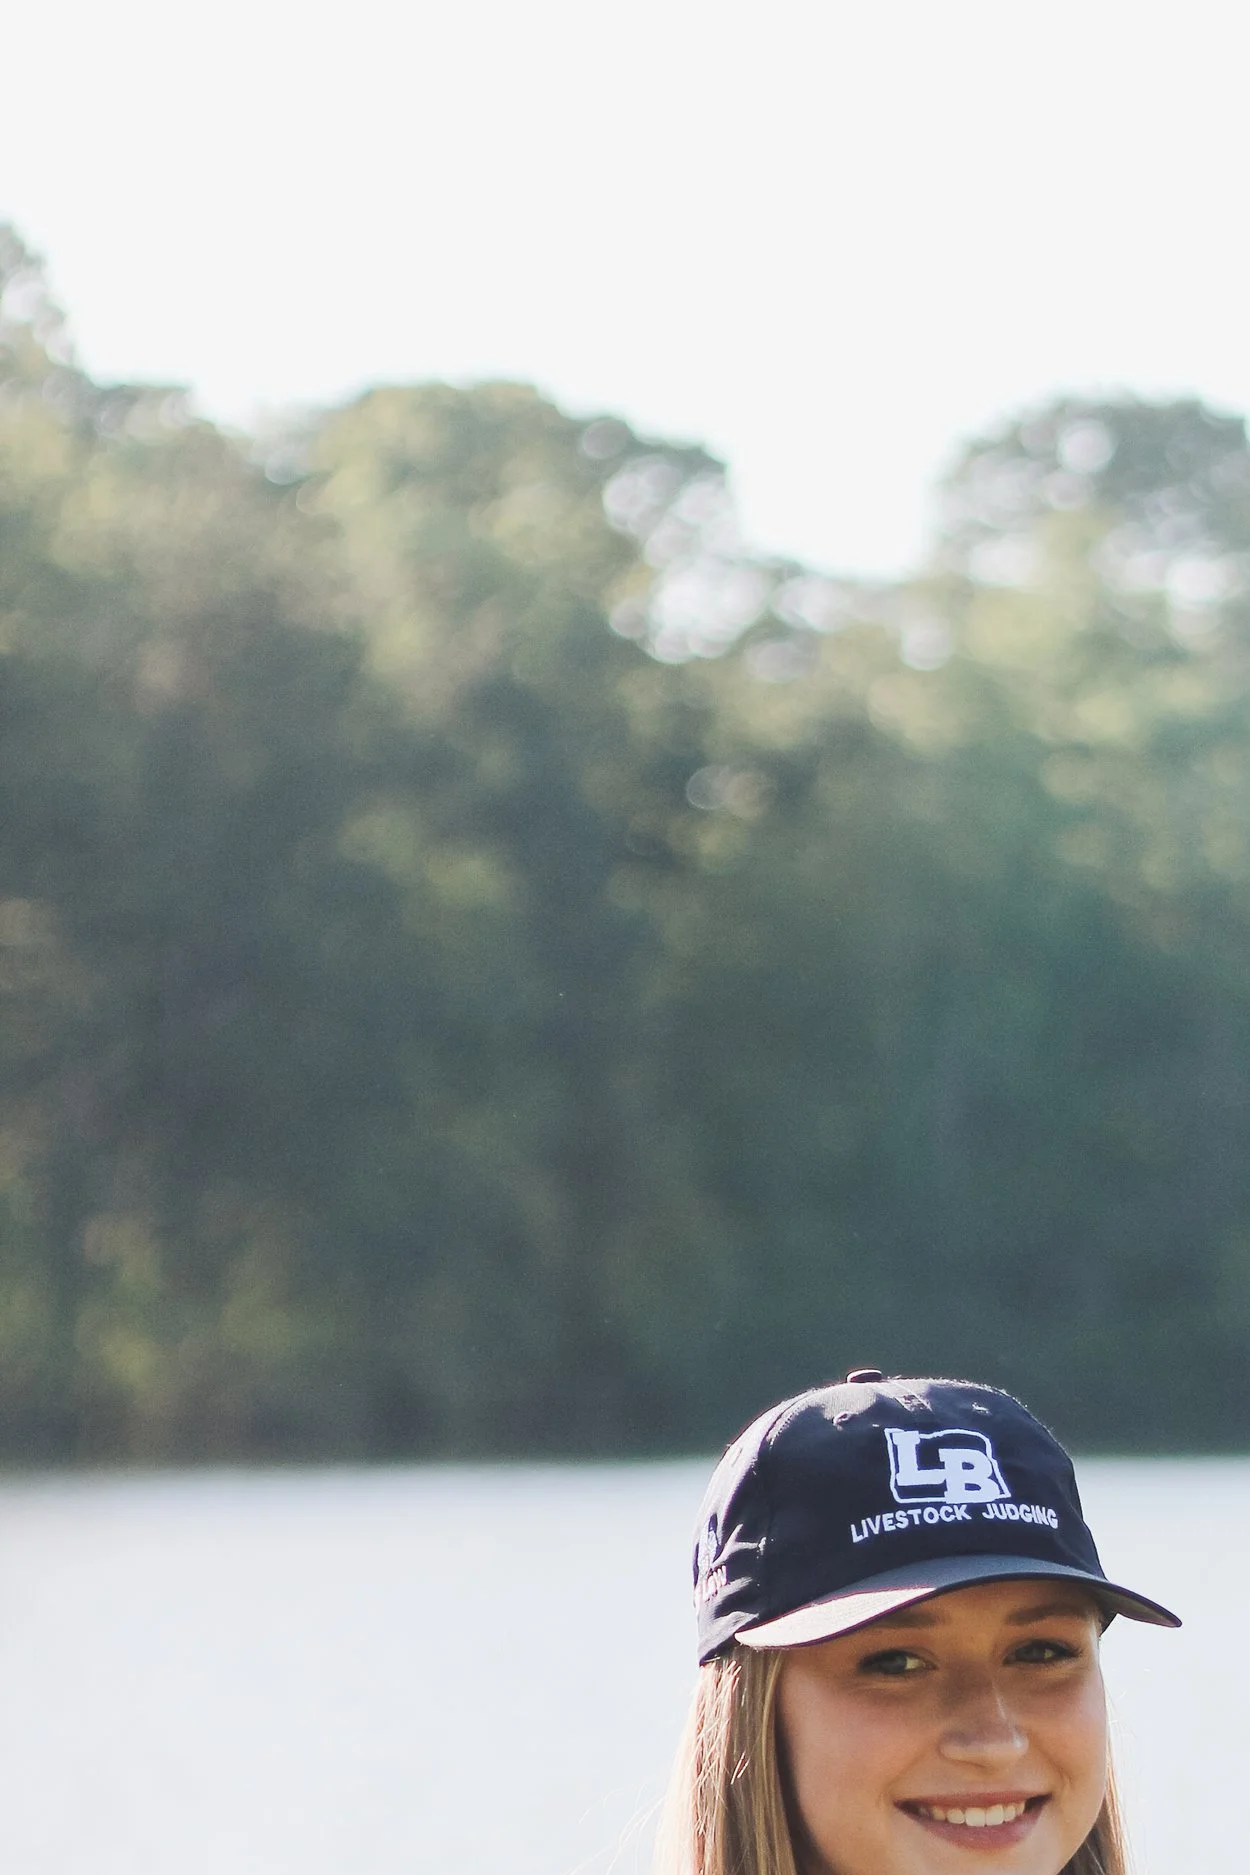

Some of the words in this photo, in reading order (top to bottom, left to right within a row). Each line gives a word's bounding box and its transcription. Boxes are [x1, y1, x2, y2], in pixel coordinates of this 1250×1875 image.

[892, 1430, 1003, 1503] LB
[850, 1504, 971, 1543] LIVESTOCK
[981, 1503, 1058, 1529] JUDGING
